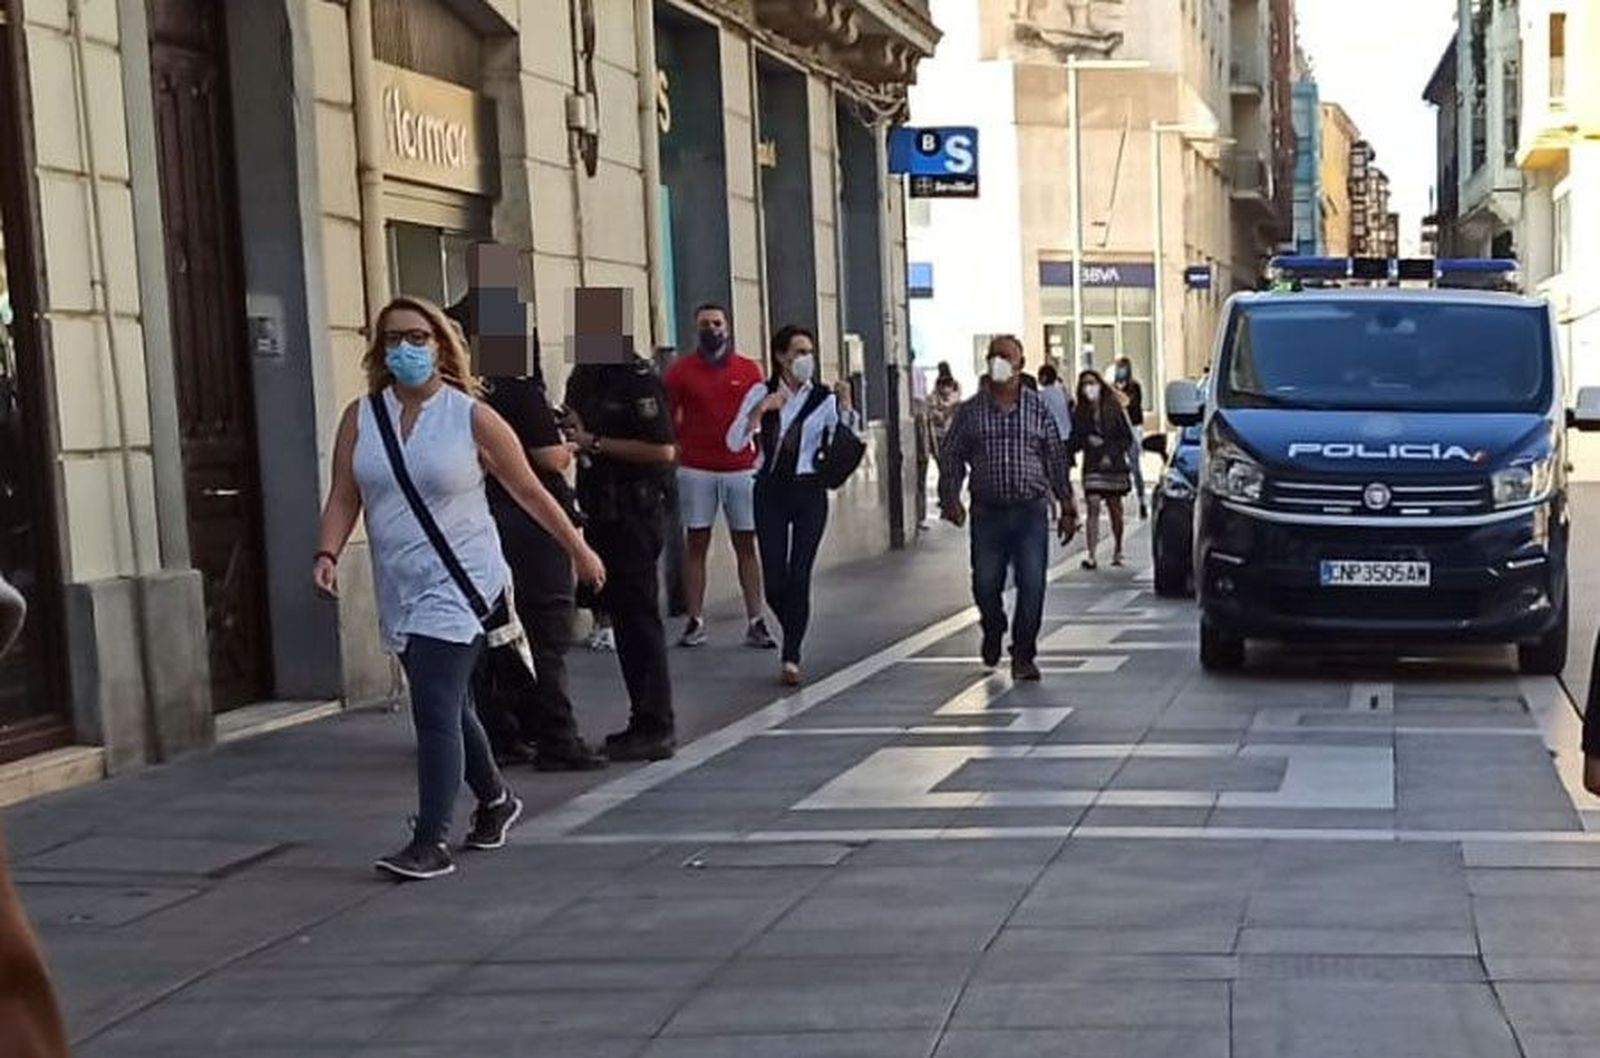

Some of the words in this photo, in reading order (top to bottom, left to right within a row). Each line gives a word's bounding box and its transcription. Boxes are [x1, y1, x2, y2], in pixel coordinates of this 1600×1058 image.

[922, 134, 936, 151] B
[943, 134, 974, 173] S
[1288, 442, 1472, 461] POLICÍA
